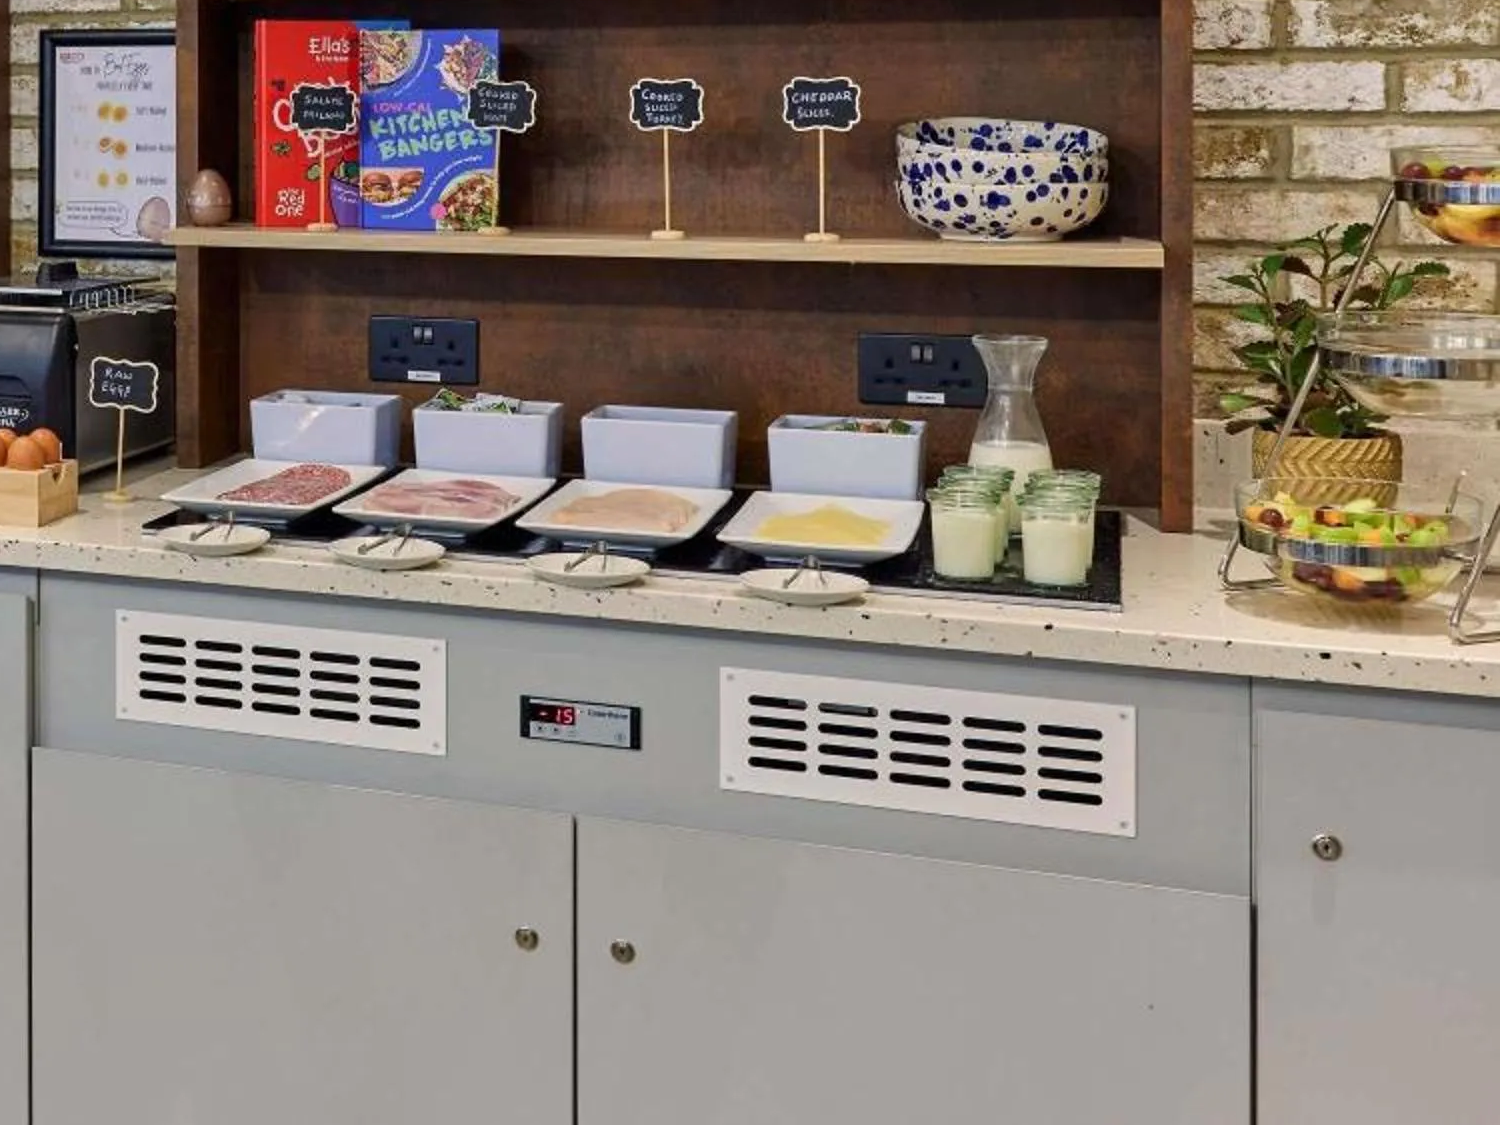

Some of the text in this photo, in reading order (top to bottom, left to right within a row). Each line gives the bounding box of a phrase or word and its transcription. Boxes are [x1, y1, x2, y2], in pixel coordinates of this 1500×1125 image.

[308, 36, 351, 54] Ella's
[791, 90, 852, 104] CHEDDAR
[378, 128, 494, 161] BANGERS
[105, 366, 133, 380] RAW
